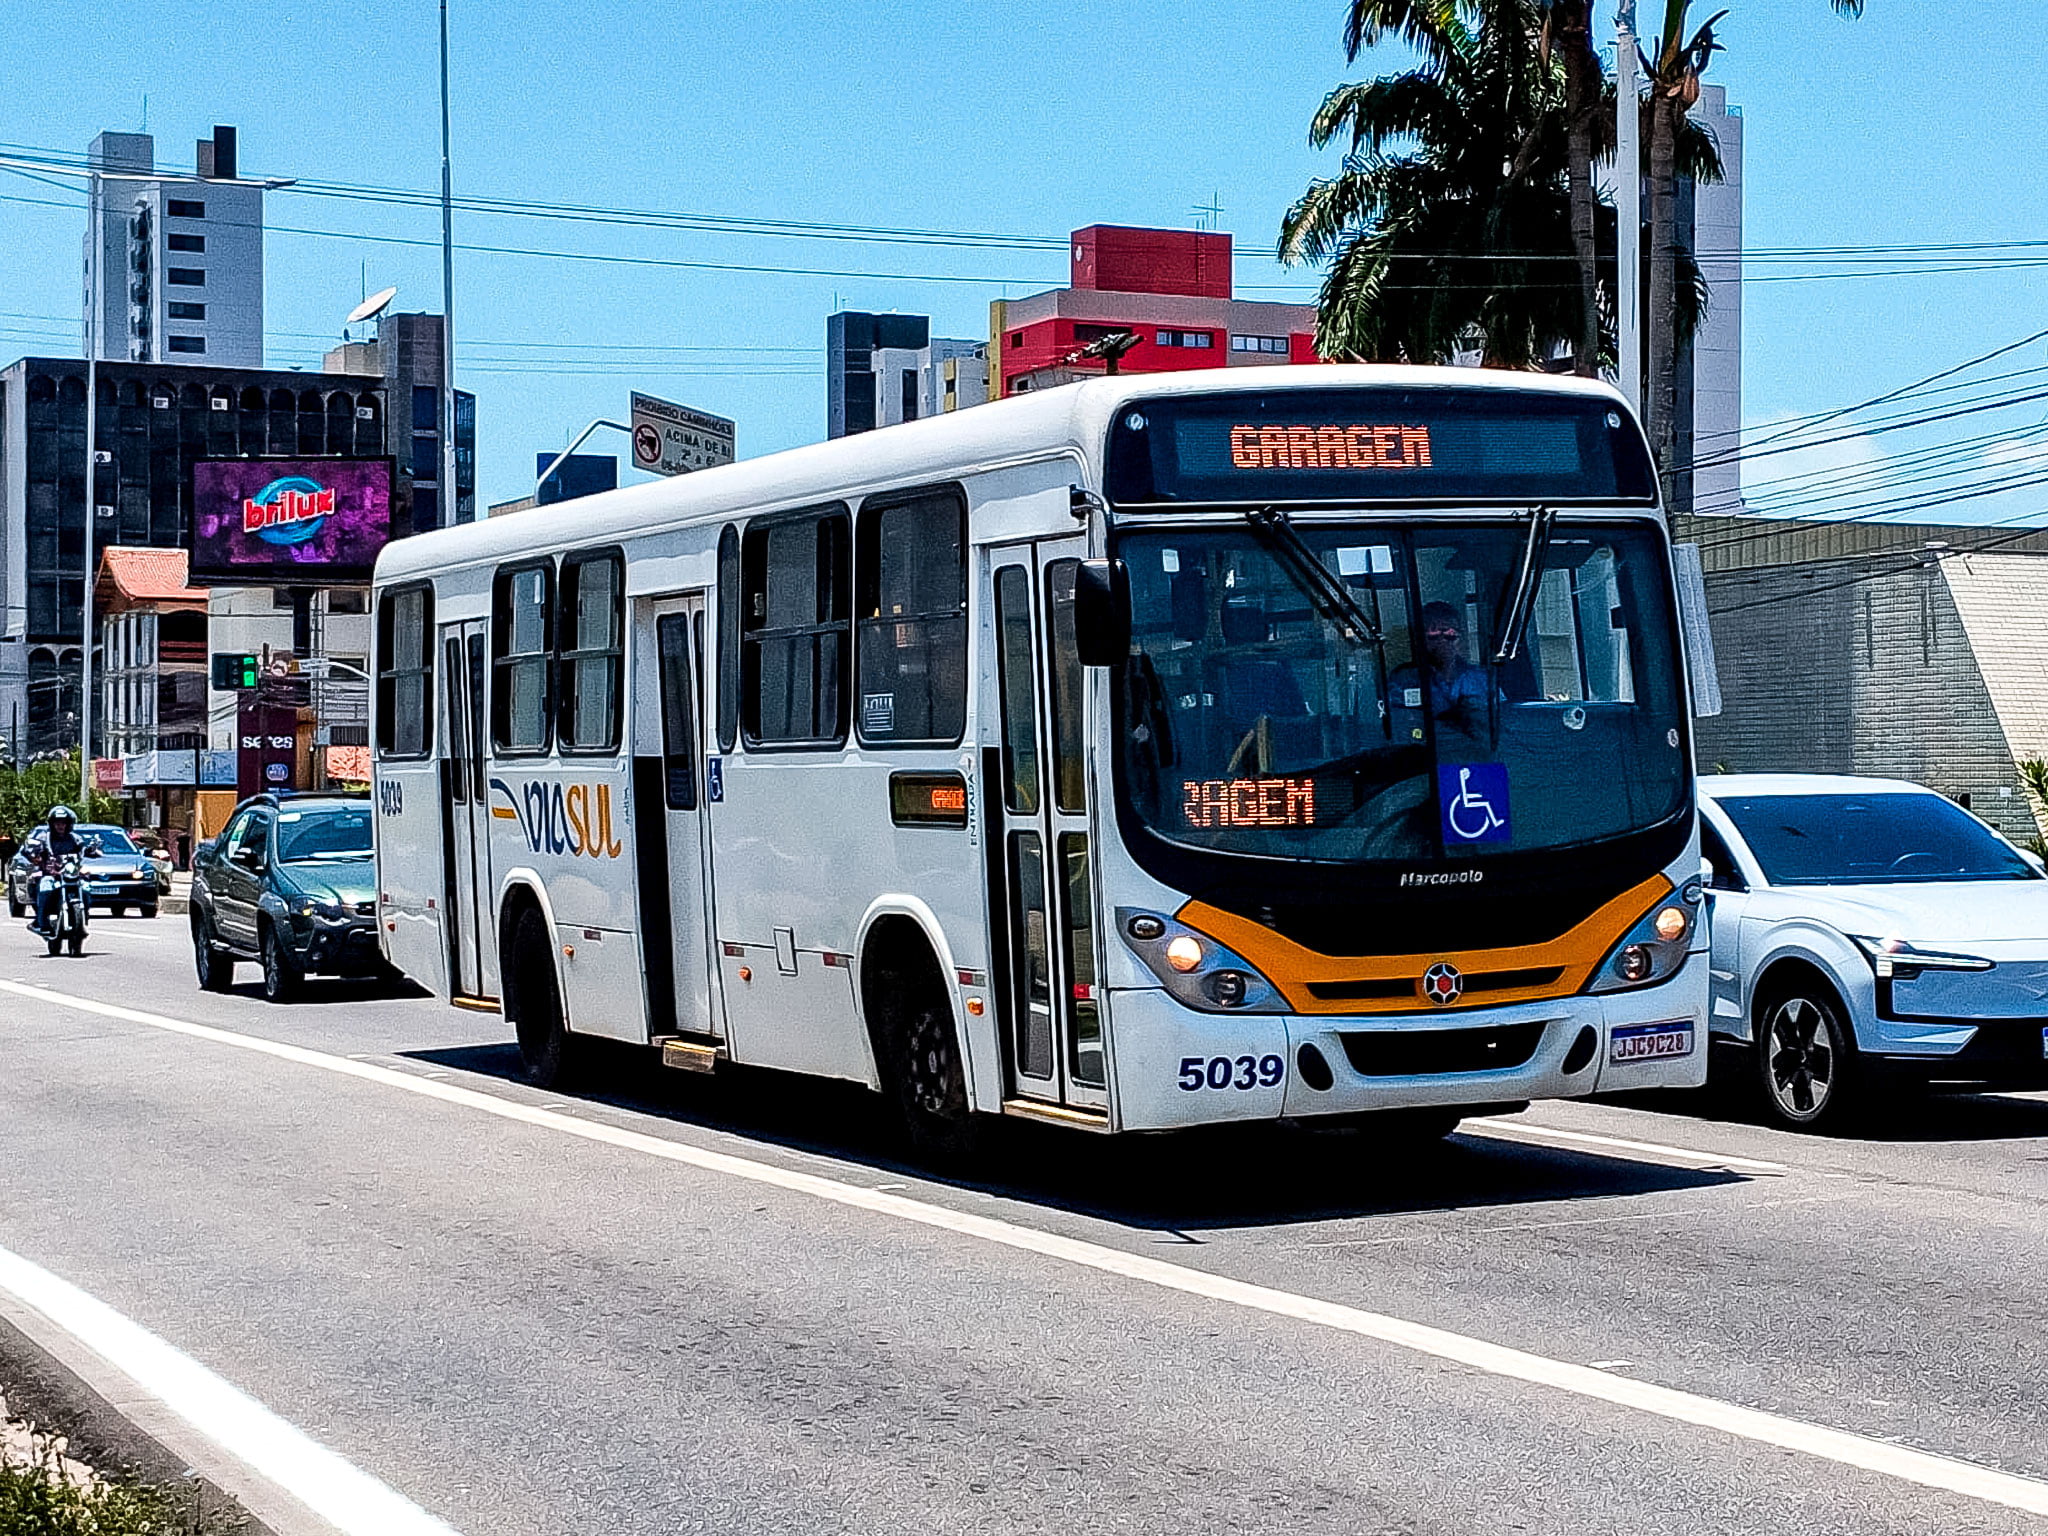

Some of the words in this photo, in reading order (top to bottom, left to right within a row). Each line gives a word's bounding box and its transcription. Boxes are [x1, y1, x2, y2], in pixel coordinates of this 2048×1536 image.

[665, 428, 700, 448] ACIMA
[704, 439, 719, 454] DE
[1230, 424, 1432, 468] GARAGEM
[243, 488, 335, 533] brilux
[967, 773, 978, 846] ENTRADA
[1400, 869, 1484, 887] Marcopolo
[1617, 1032, 1684, 1058] JJC9C28
[1178, 1054, 1285, 1092] 5039
